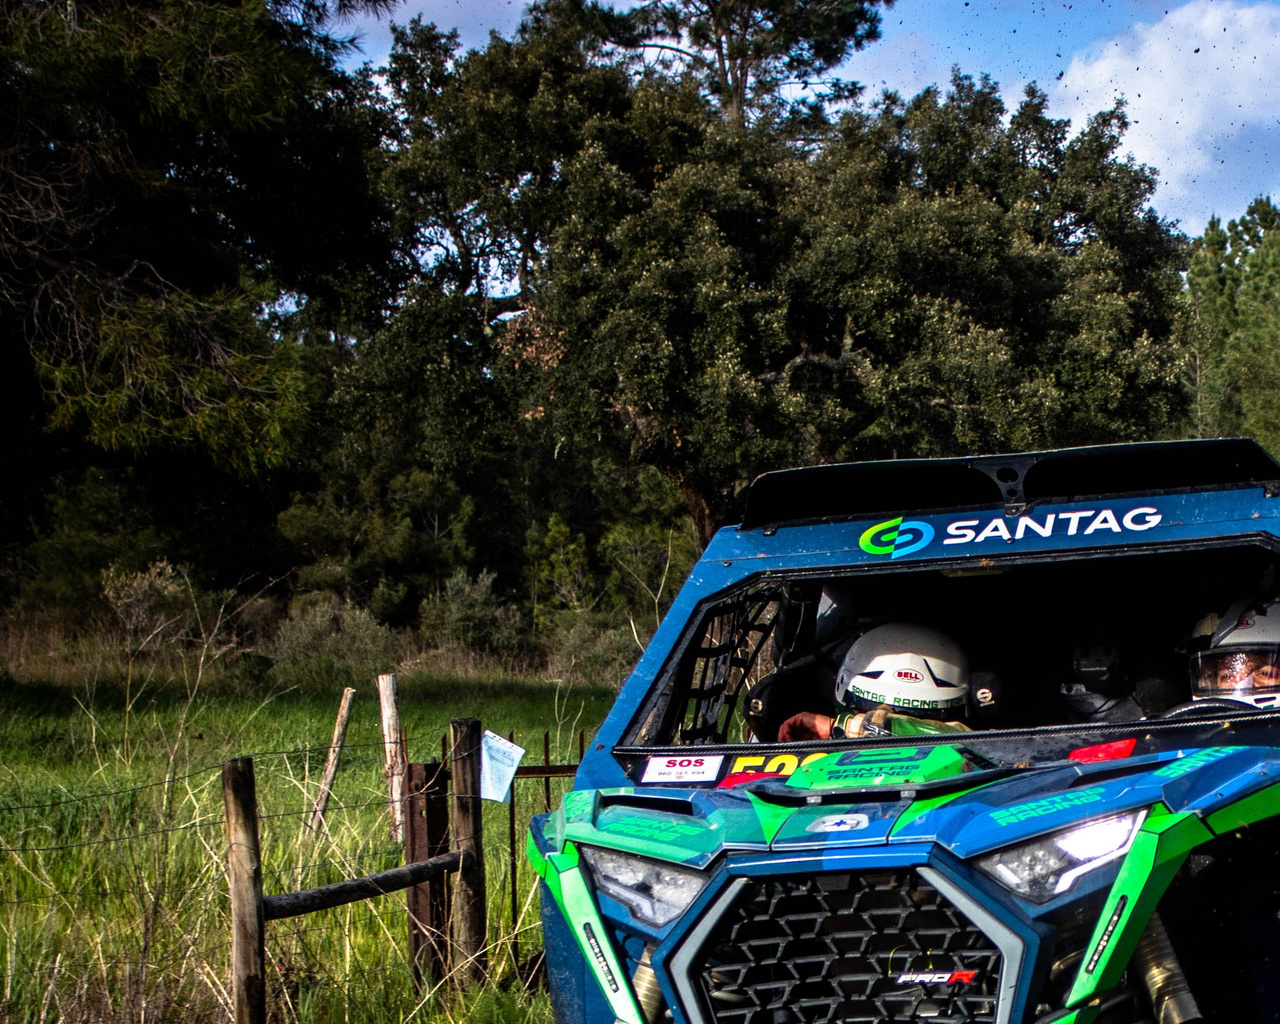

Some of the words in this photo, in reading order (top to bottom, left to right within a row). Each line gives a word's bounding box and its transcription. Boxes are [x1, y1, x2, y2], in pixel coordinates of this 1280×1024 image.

[943, 507, 1162, 545] SANTAG
[897, 671, 920, 680] BELL
[893, 698, 938, 708] RACING
[665, 759, 704, 768] SOS
[826, 765, 921, 775] SANTAG
[827, 770, 912, 781] RACING
[989, 787, 1106, 820] SANTAG
[996, 794, 1102, 827] RACING
[601, 823, 681, 842] RACING
[618, 817, 706, 836] SANTAG
